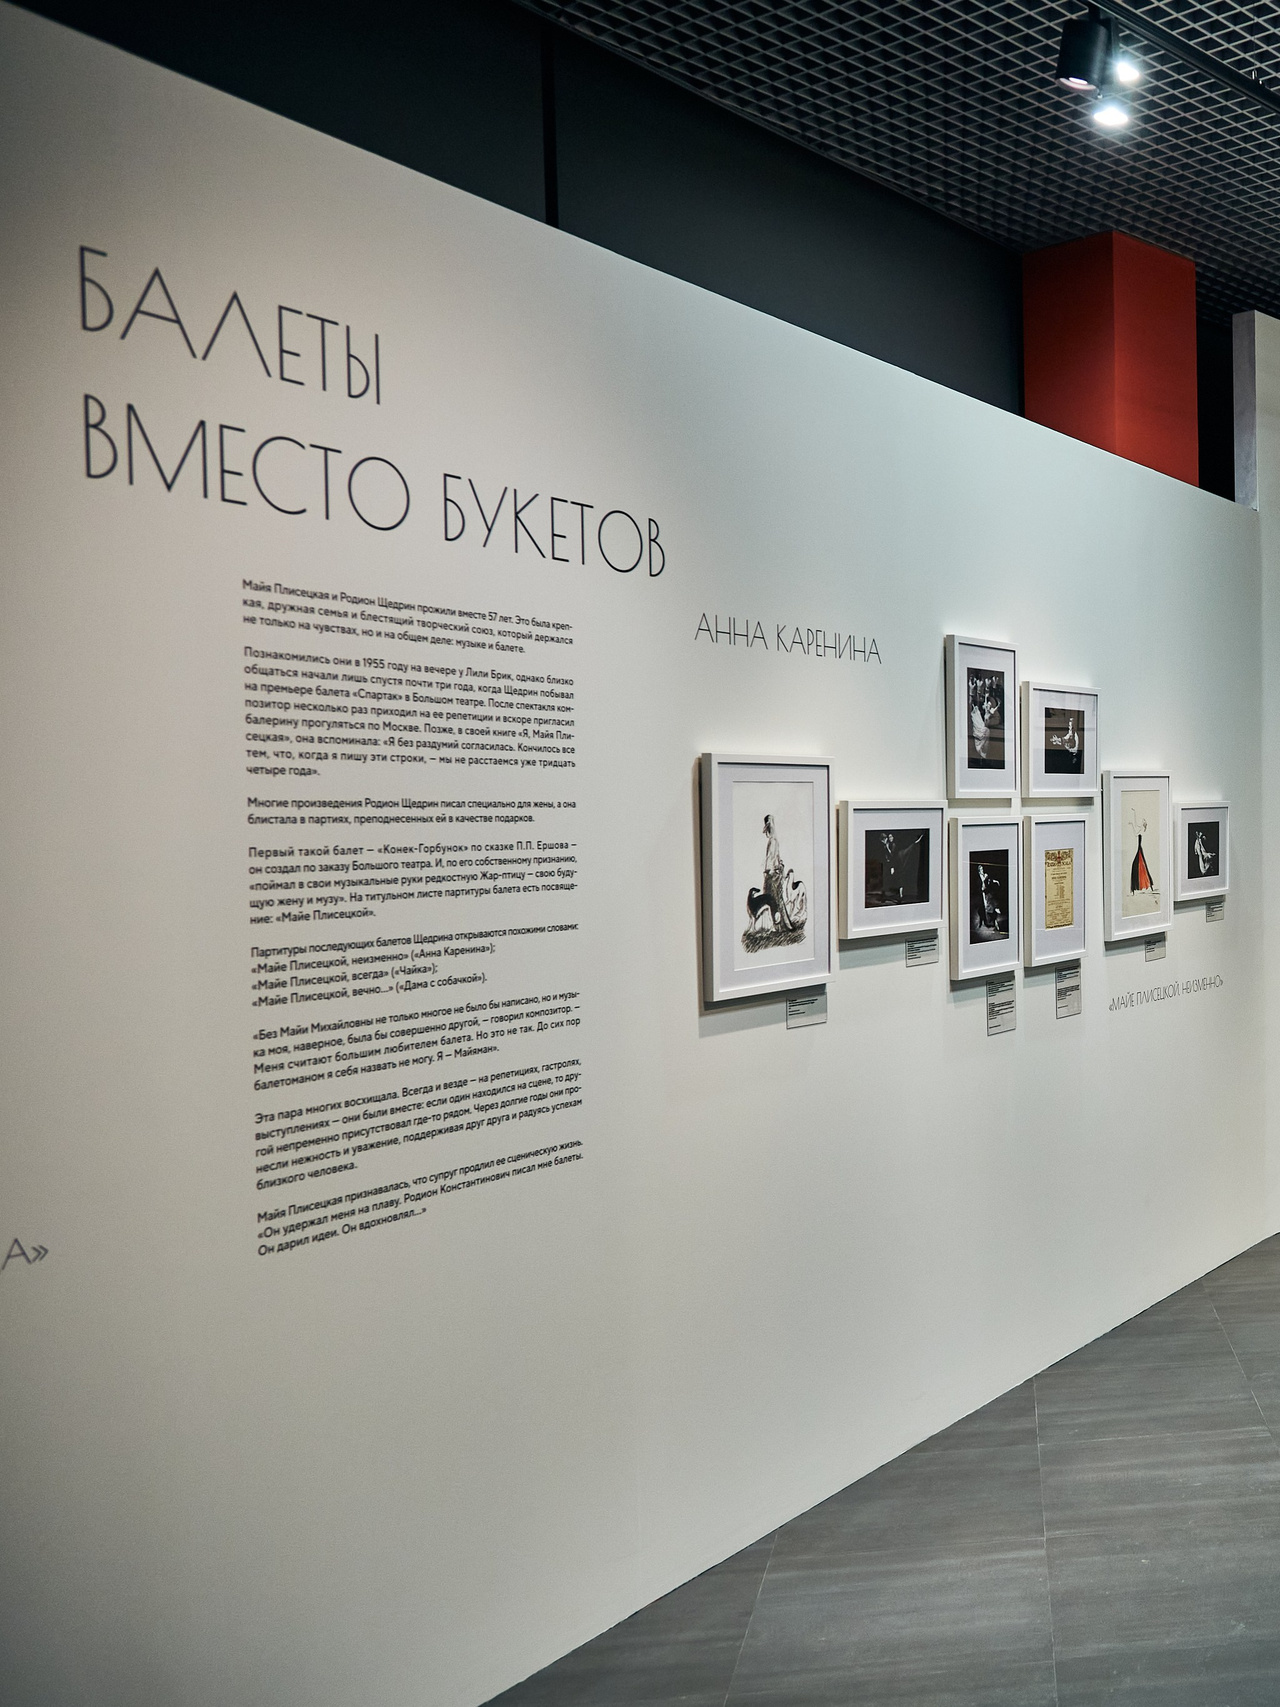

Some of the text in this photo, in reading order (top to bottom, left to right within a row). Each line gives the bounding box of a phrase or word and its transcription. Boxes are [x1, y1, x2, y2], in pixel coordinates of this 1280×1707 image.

[79, 245, 382, 405] БАЛЕТЫ
[83, 393, 666, 578] ВМЕСТО БУКЕТОВ
[273, 582, 488, 621] Плисецкая Родион Щедрин прожили вместе
[258, 616, 297, 630] только
[455, 639, 488, 650] музыке
[266, 601, 574, 646] дружная блестящий творческий который держался
[695, 612, 882, 664] АННА КАРЕНИНА
[243, 645, 575, 687] Познакомились 1955 вечере однако близко
[243, 663, 575, 700] общаться начали спустя Щедрин побывал
[260, 683, 314, 697] премьере
[314, 684, 351, 699] балета
[412, 691, 454, 705] Большом
[515, 702, 556, 712] спектакля
[244, 699, 576, 728] позитор несколько приходил репетиции вскоре пригласил
[244, 712, 300, 730] балерину
[301, 718, 366, 732] прогуляться
[415, 739, 460, 752] раздумий
[517, 742, 562, 755] Кончилось
[467, 756, 520, 767] расстаемся
[538, 759, 577, 769] тридцать
[245, 766, 287, 778] четыре
[247, 796, 517, 811] Многие произведения Родион Щедрин специально
[247, 813, 299, 825] блистала
[353, 815, 435, 827] преподнесенных
[454, 815, 494, 824] качестве
[248, 846, 295, 861] Первый
[484, 843, 515, 852] сказке
[536, 840, 570, 853] Ершова
[264, 864, 302, 875] создал
[317, 863, 351, 875] заказу
[351, 859, 400, 872] Большого
[474, 855, 533, 867] собственному
[333, 876, 400, 891] музыкальные
[424, 873, 479, 886] редкостную
[479, 870, 527, 883] Жар-птицу
[364, 891, 416, 904] титульном
[444, 887, 492, 900] партитуры
[492, 884, 522, 895] балета
[250, 945, 308, 960] Партитуры
[308, 940, 376, 954] последующих
[375, 936, 413, 948] балетов
[412, 933, 455, 946] Щедрина
[454, 929, 508, 942] открываются
[507, 926, 547, 937] похожими
[1108, 991, 1134, 1011] «МАЙЕ
[1182, 974, 1224, 994] НЕИЗМЕННО»
[310, 1018, 375, 1034] Михайловны
[388, 1011, 421, 1023] только
[420, 1007, 453, 1019] многое
[389, 1023, 448, 1039] совершенно
[490, 1012, 525, 1024] говорил
[287, 1054, 333, 1070] считают
[334, 1048, 382, 1063] большим
[383, 1039, 439, 1056] любителем
[253, 1072, 326, 1092] балетоманом
[360, 1061, 398, 1074] назвать
[254, 1119, 331, 1142] выступлениях
[471, 1084, 517, 1100] находился
[305, 1101, 343, 1116] многих
[401, 1084, 435, 1099] Всегда
[275, 1095, 529, 1154] непременно присутствовал где-то долгие
[290, 1149, 342, 1167] нежность
[402, 1123, 465, 1144] поддерживая
[518, 1106, 551, 1122] радуясь
[550, 1098, 583, 1115] успехам
[256, 1172, 306, 1191] близкого
[287, 1195, 344, 1217] Плисецкая
[428, 1168, 459, 1185] супруг
[458, 1159, 496, 1177] продлил
[506, 1144, 559, 1164] сценическую
[282, 1215, 329, 1237] удержал
[403, 1188, 439, 1204] Родион
[439, 1170, 511, 1195] Константинович
